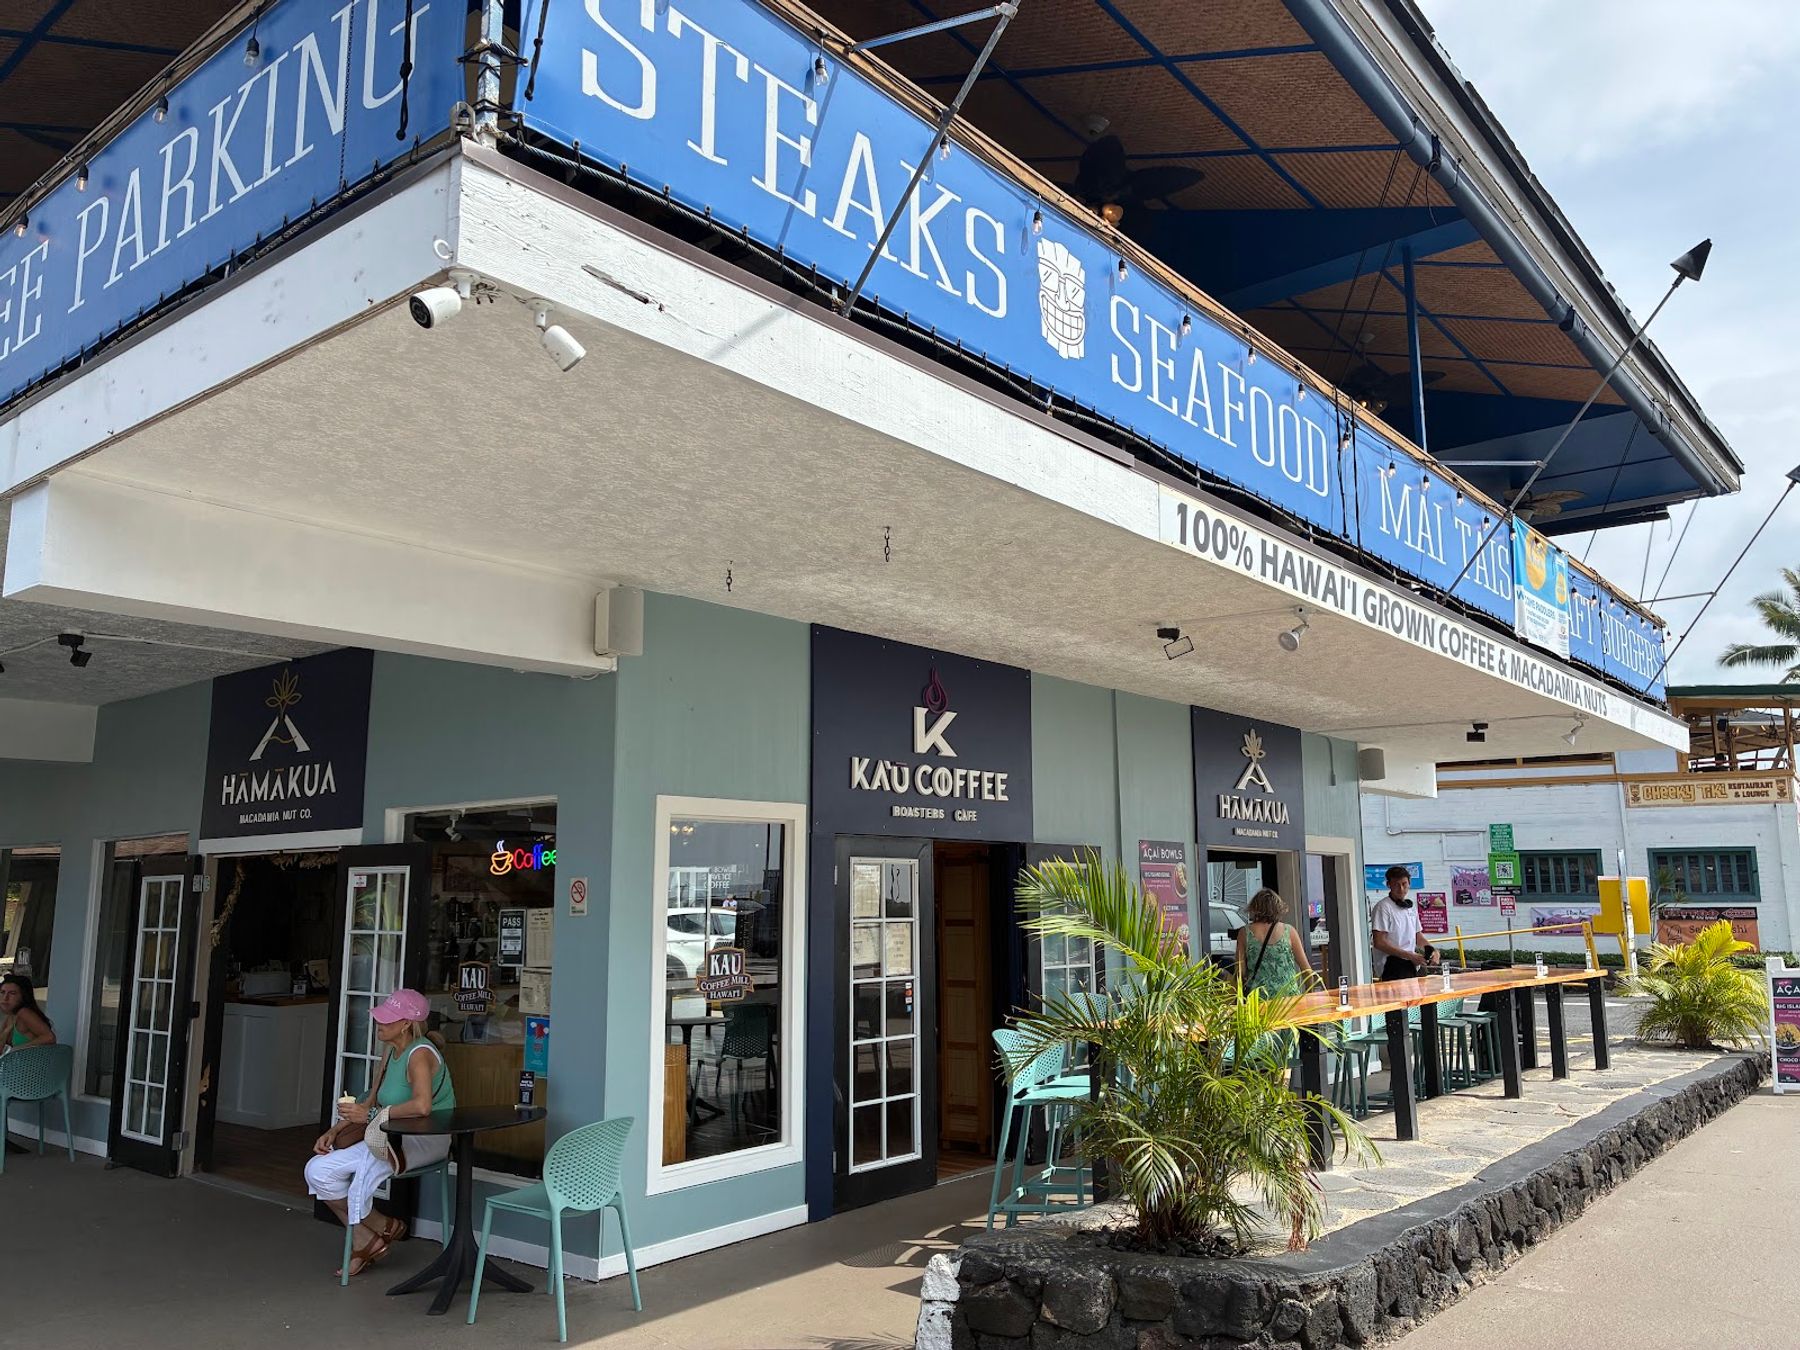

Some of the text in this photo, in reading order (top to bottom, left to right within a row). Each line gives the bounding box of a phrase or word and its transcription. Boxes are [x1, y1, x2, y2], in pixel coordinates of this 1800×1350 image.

[68, 0, 430, 314] PARKING
[582, 0, 1661, 684] STEAKS SEAFOOD MAI TAIS AFT BURGERS
[1177, 502, 1607, 717] 100% HAWAI'I GROWN COFFEE & MACADAMIA NUTS
[913, 706, 958, 757] K
[221, 761, 336, 806] HĀMĀKUA
[914, 764, 1009, 801] COFFEE
[1728, 781, 1773, 790] RESTAURANT
[1742, 790, 1770, 798] LOUNGE
[239, 808, 312, 824] MACADAMIA NUT CO.
[892, 805, 977, 822] ROASTERS CAFE
[513, 843, 557, 870] Coffee
[1161, 848, 1183, 860] BOWLS
[502, 917, 521, 927] PASS
[700, 976, 750, 991] COFFEE MILL
[454, 989, 493, 1001] COFFEE MILL
